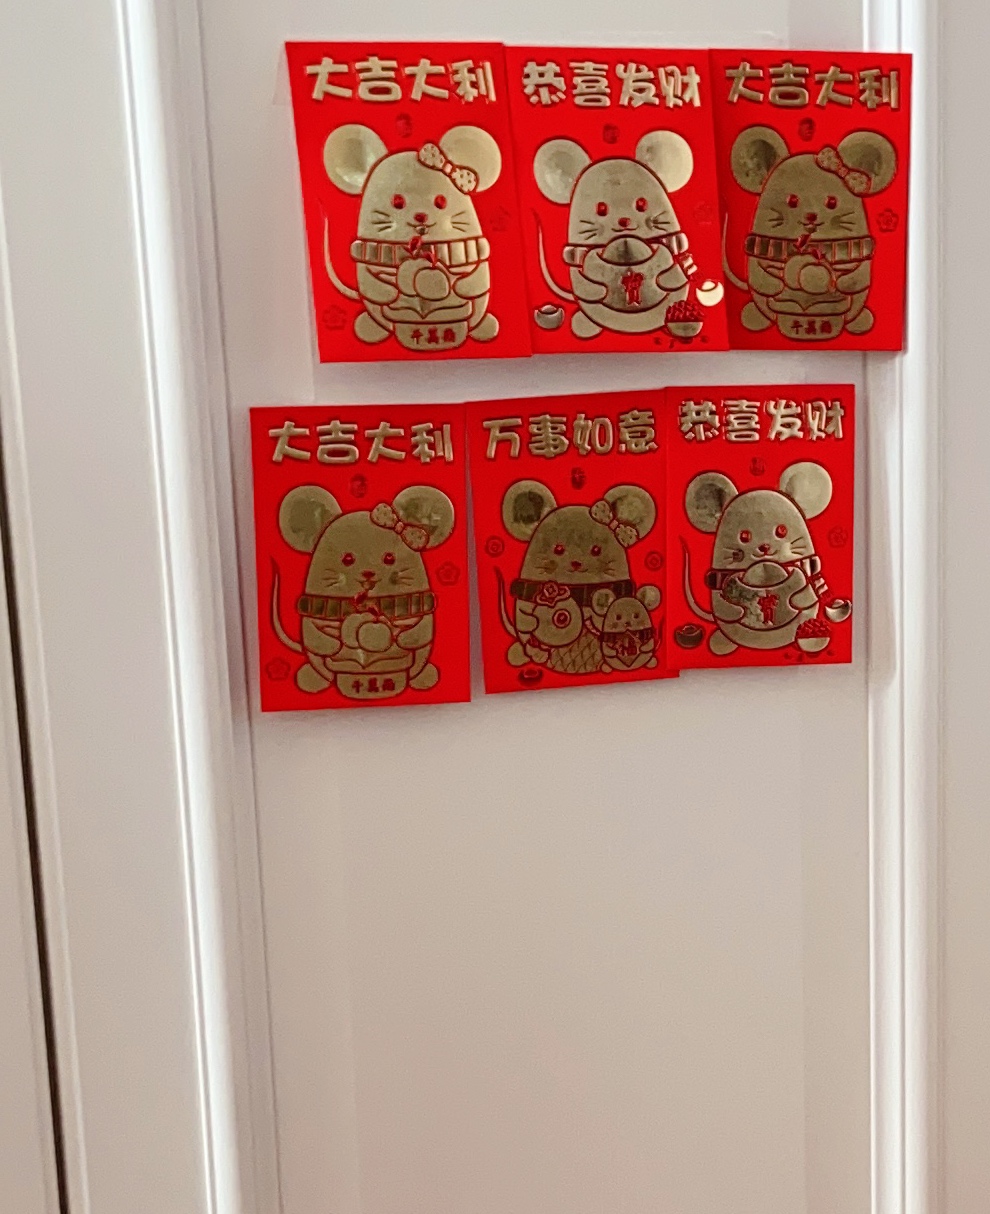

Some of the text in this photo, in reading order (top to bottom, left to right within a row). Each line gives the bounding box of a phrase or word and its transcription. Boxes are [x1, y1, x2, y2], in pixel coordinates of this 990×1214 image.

[305, 56, 497, 103] 大吉大利
[521, 61, 702, 109] 恭喜发财
[725, 61, 900, 109] 大吉大利
[268, 418, 455, 465] 大吉大利
[482, 409, 660, 459] 万事如意
[680, 399, 846, 443] 恭喜发财
